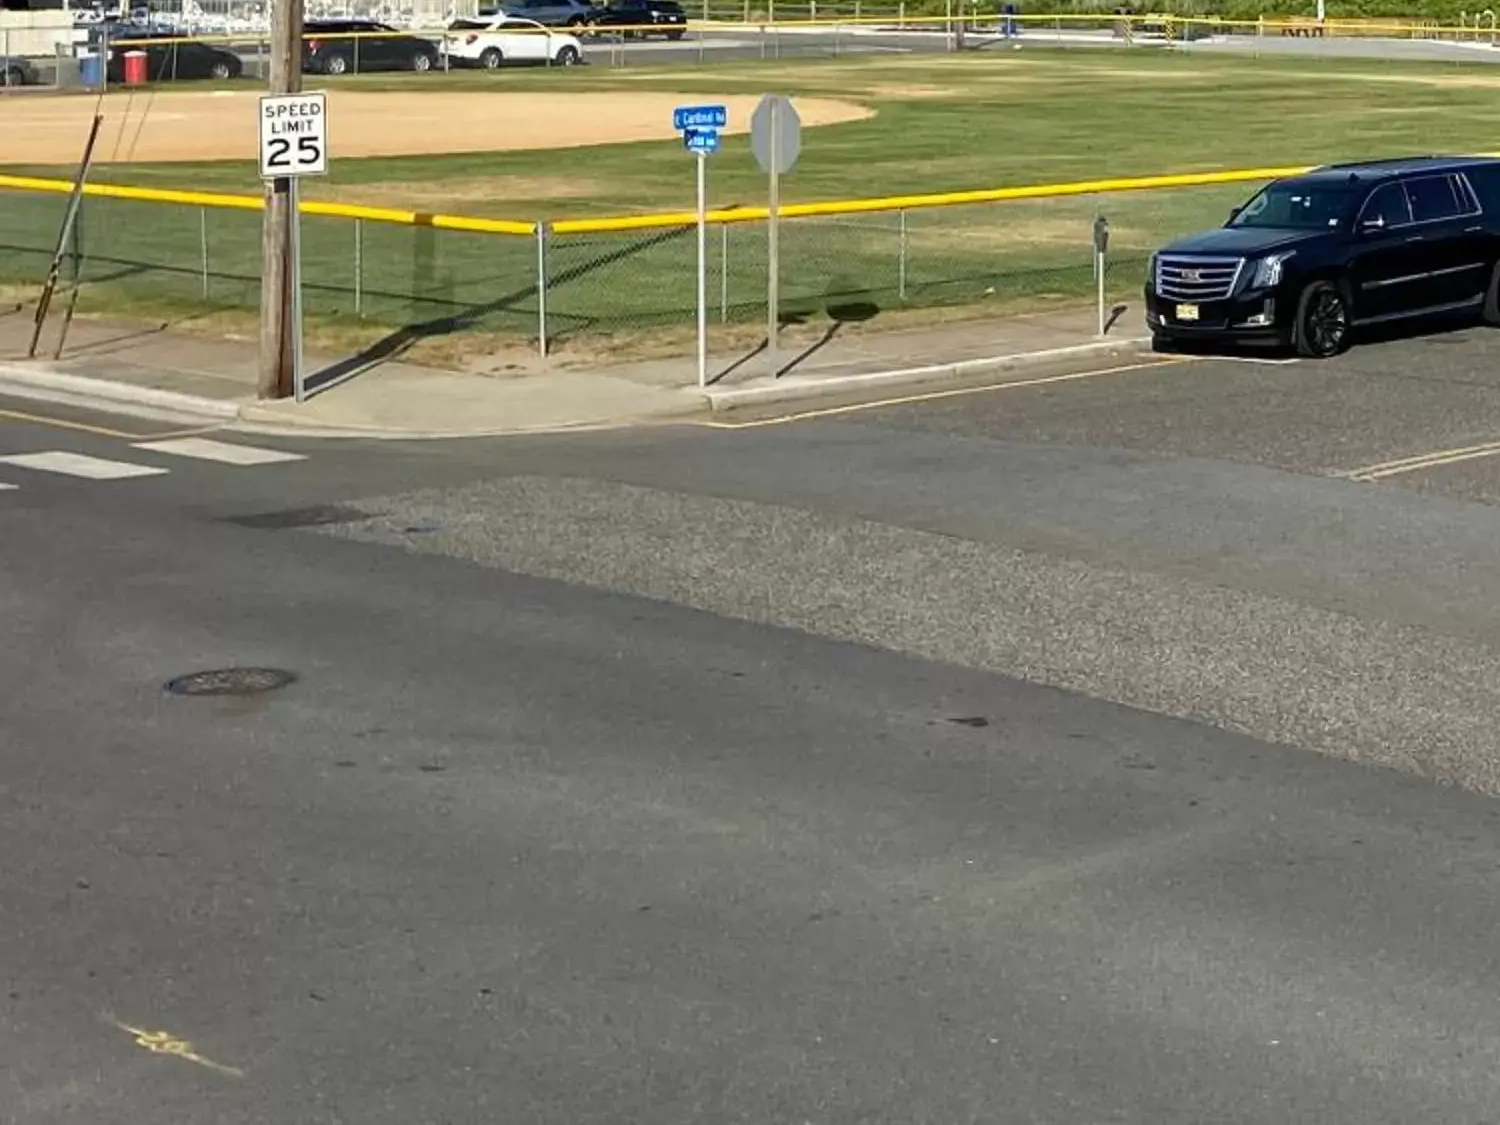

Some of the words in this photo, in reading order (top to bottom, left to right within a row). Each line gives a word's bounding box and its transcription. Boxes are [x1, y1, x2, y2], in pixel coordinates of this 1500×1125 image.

[265, 103, 321, 118] SPEED
[271, 120, 314, 134] LIMIT
[267, 136, 320, 167] 25
